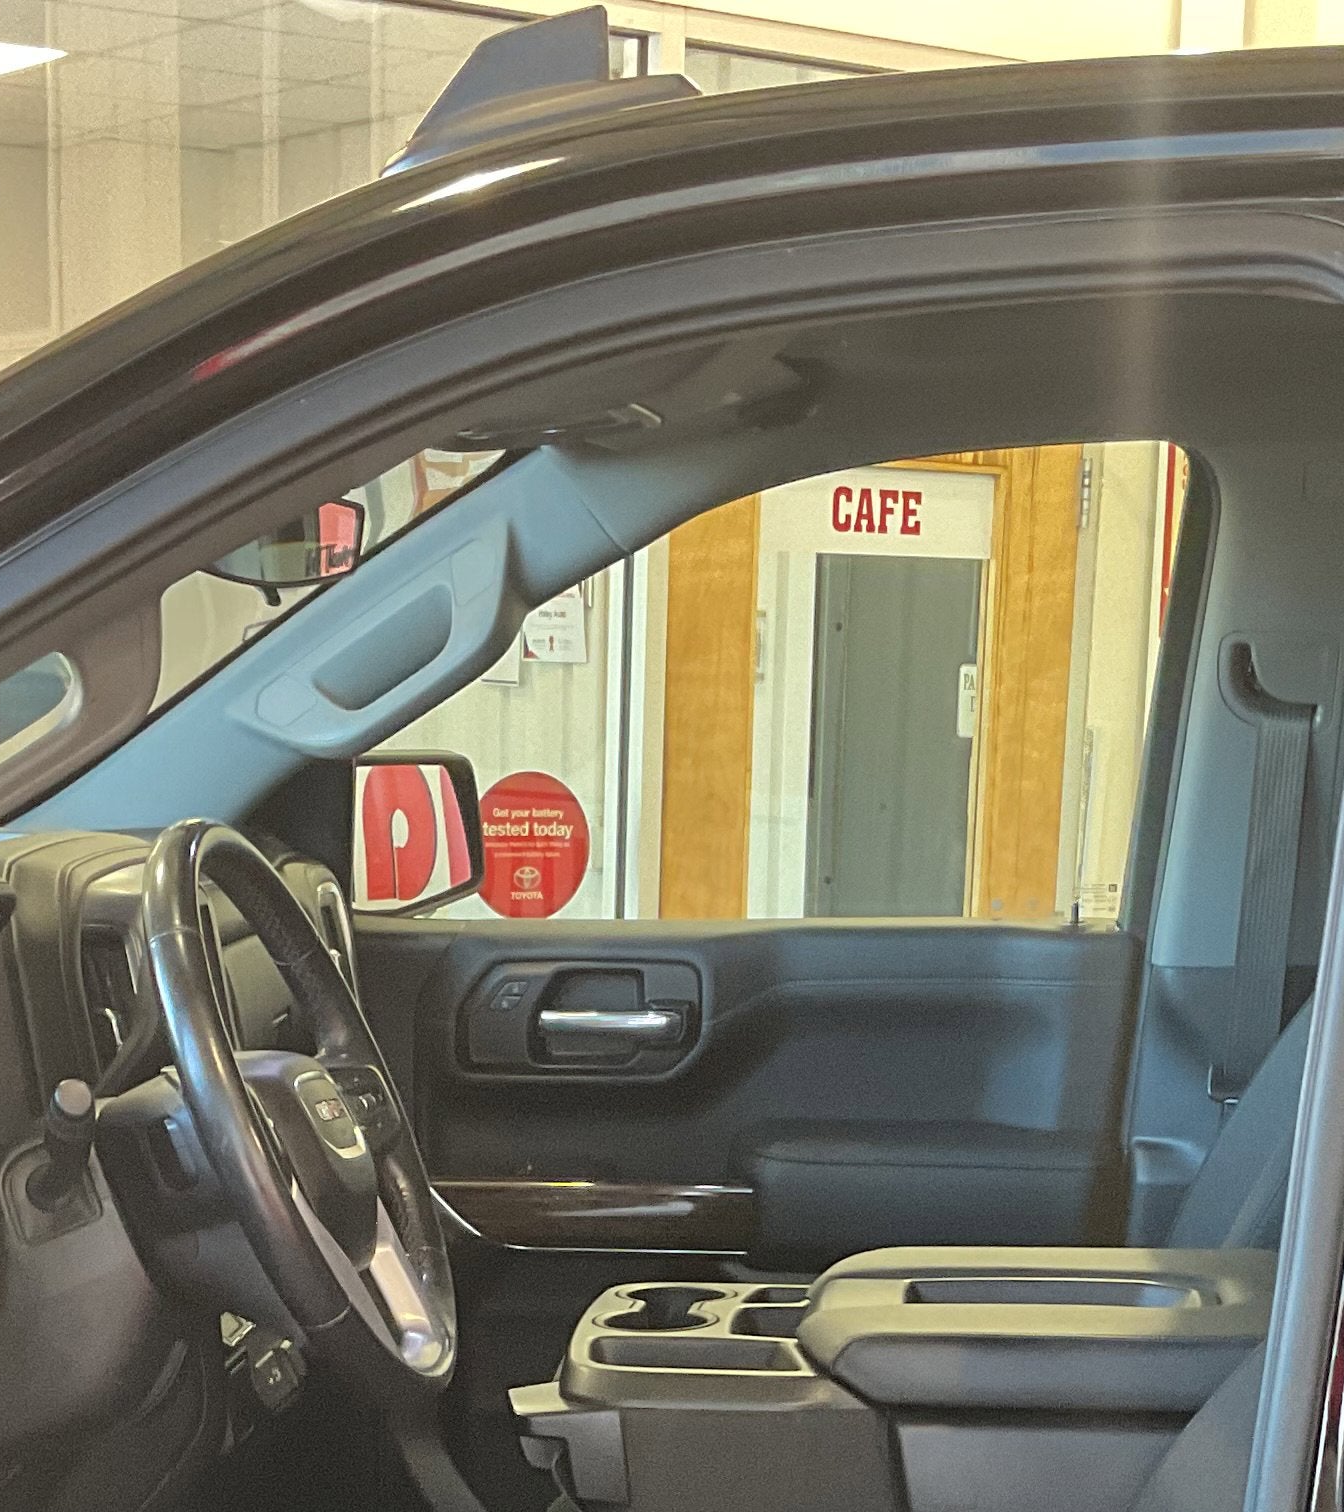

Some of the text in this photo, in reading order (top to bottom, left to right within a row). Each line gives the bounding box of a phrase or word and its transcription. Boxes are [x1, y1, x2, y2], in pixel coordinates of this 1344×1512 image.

[832, 486, 923, 535] CAFE
[492, 808, 564, 820] Get your battery
[482, 821, 574, 839] tested today
[511, 892, 544, 900] TOYOTA
